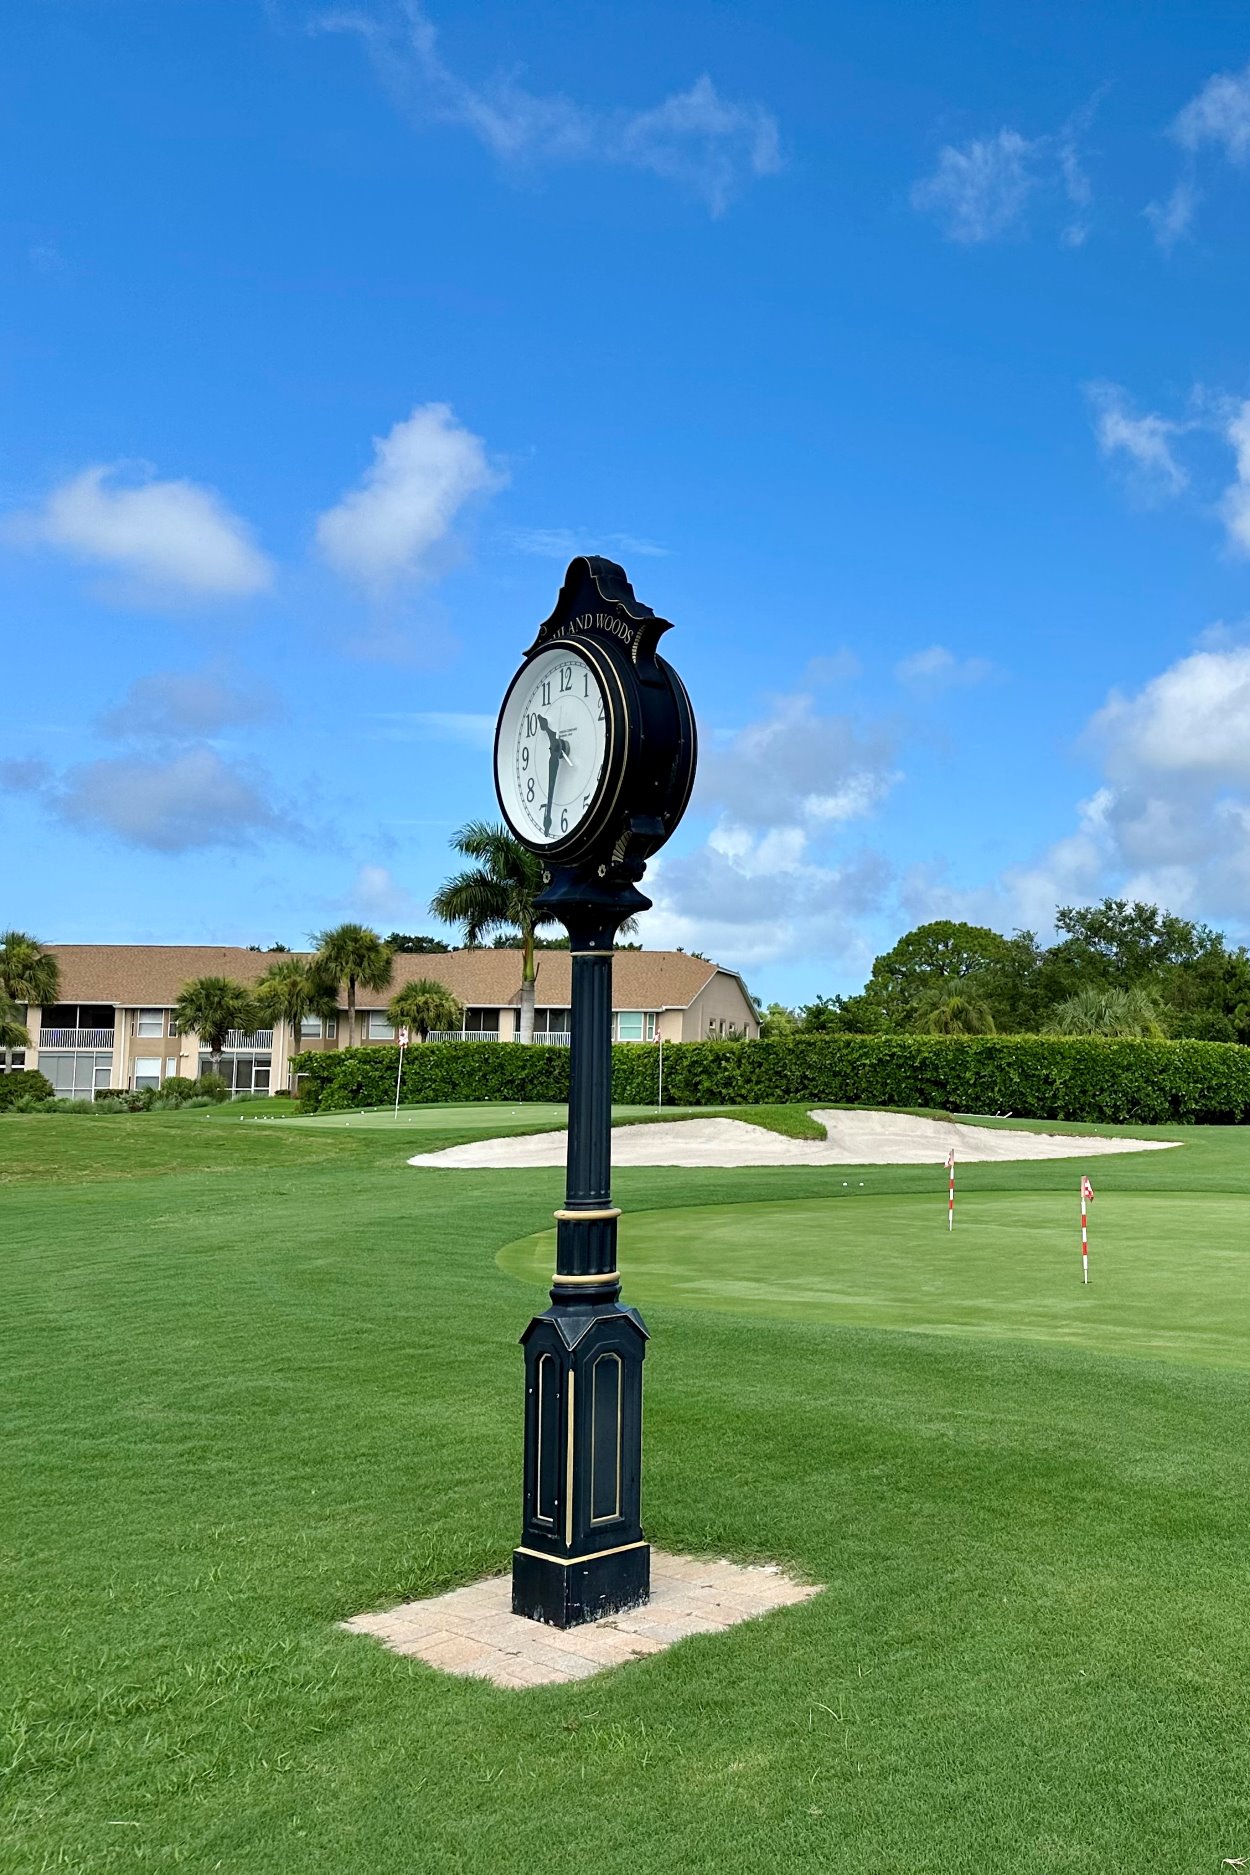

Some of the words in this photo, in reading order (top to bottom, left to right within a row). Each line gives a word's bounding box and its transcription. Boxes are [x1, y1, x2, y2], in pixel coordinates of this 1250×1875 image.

[596, 613, 634, 644] WOODS
[559, 667, 572, 693] 12
[584, 673, 589, 698] 1
[541, 681, 551, 707] 11
[526, 712, 538, 738] 10
[522, 747, 530, 771] 9
[526, 778, 535, 803] 8
[560, 808, 569, 833] 6
